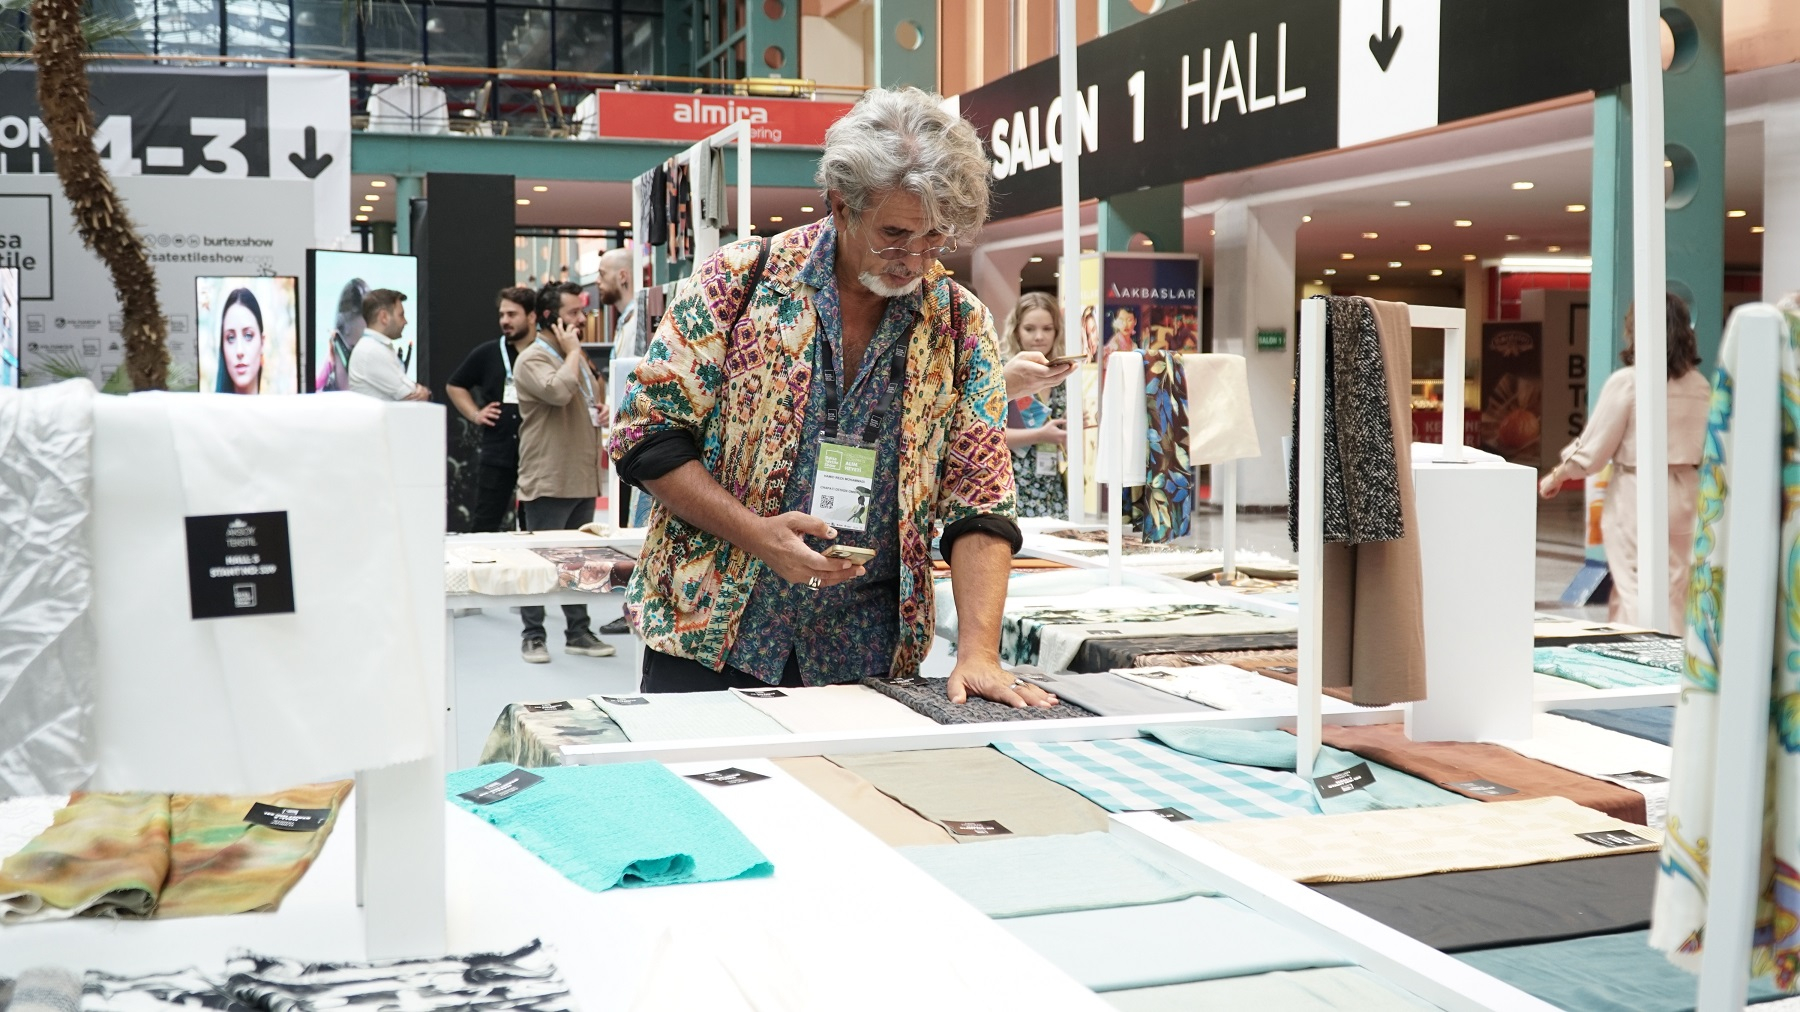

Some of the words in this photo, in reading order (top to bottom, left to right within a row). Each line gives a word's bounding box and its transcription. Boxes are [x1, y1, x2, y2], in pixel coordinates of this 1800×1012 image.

[673, 98, 768, 124] almira
[991, 85, 1098, 180] SALON
[1127, 70, 1145, 143] 1
[1181, 22, 1306, 130] HALL
[750, 126, 782, 142] ering
[203, 236, 274, 247] burtexshow
